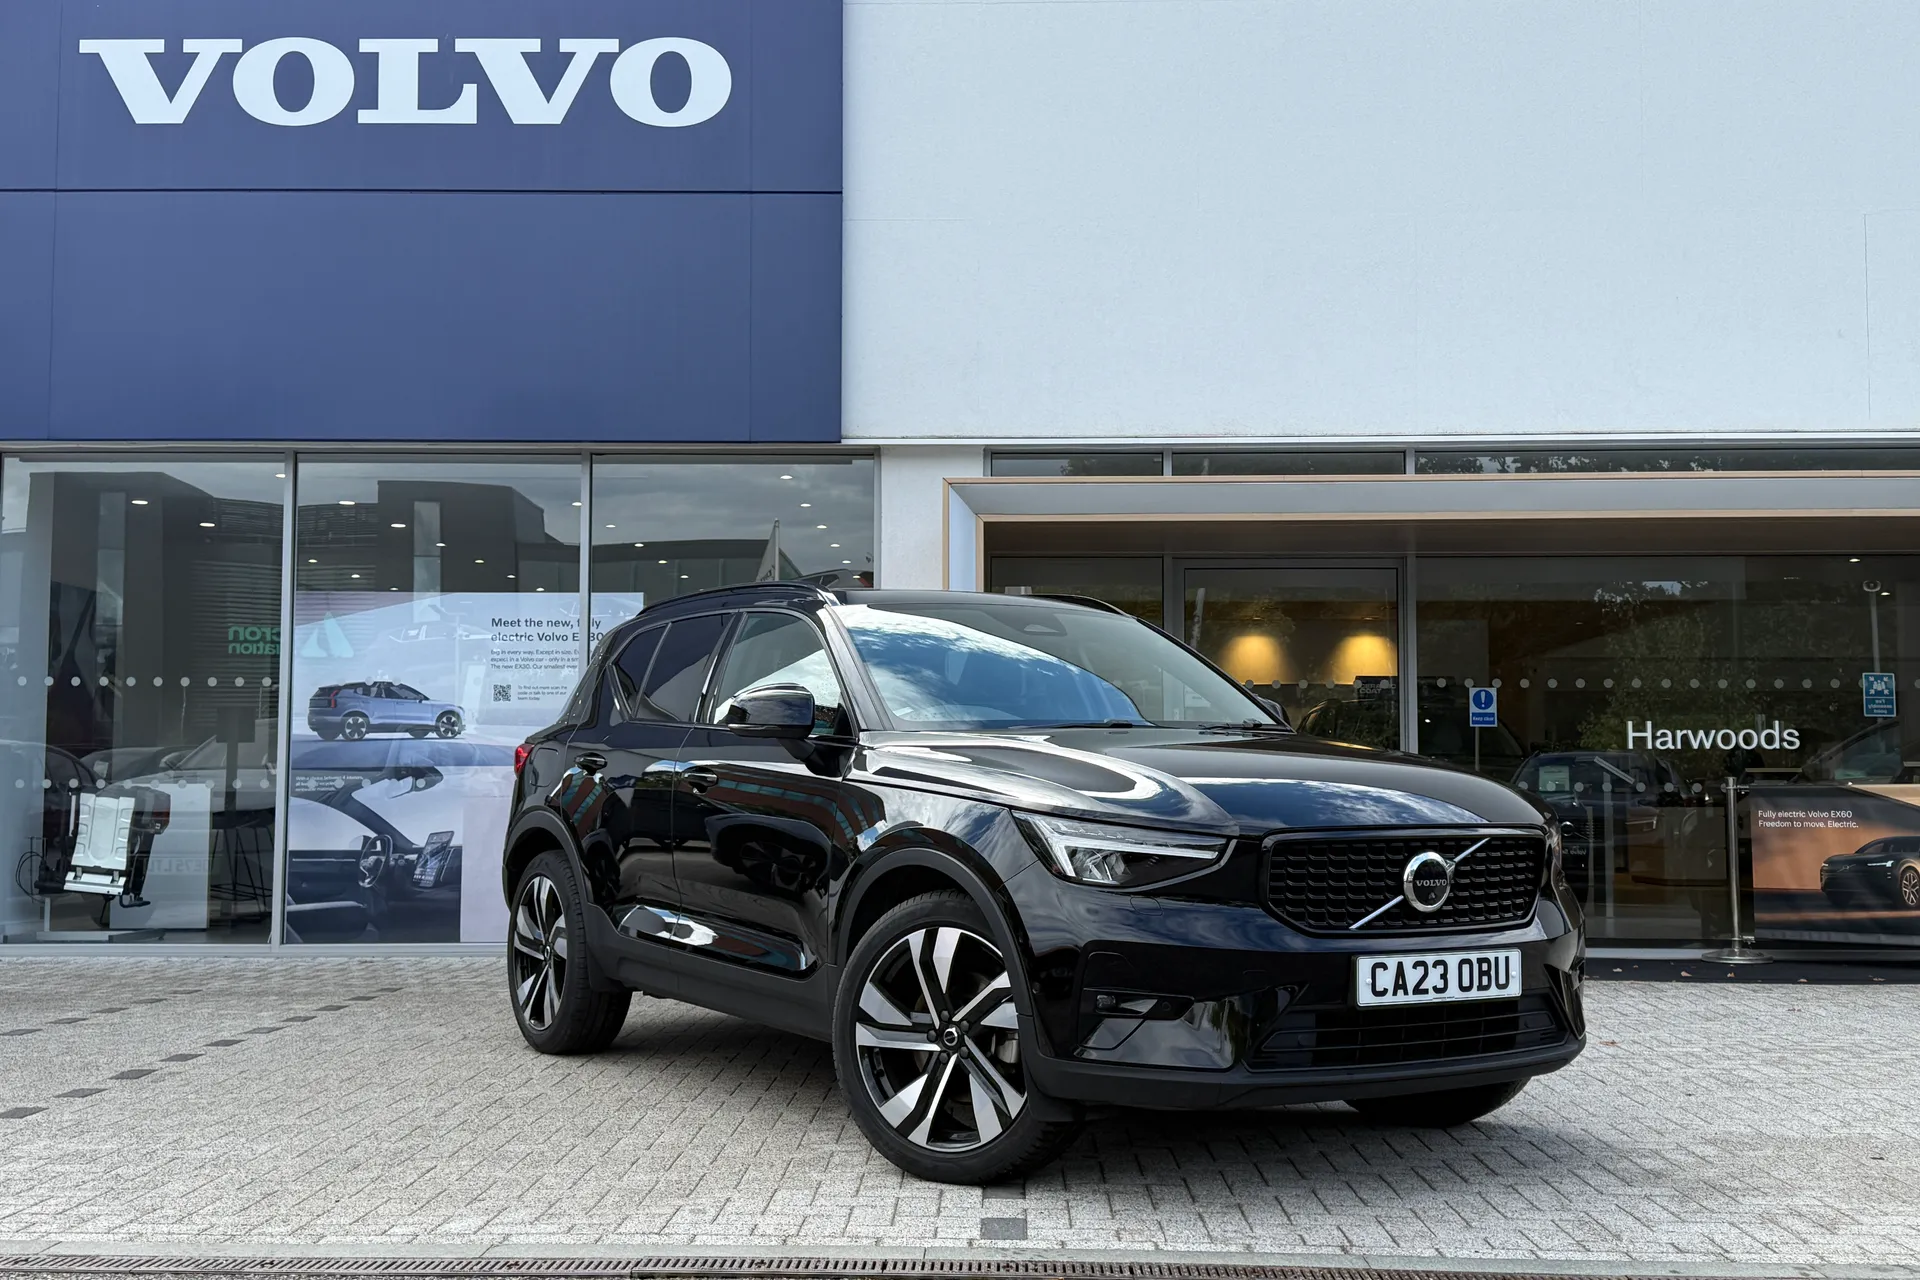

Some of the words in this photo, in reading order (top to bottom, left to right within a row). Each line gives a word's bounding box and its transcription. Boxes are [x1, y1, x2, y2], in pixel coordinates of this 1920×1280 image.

[79, 37, 732, 127] VOLVO
[491, 618, 521, 628] Meet
[525, 618, 543, 628] the
[547, 619, 574, 629] new,
[577, 618, 602, 629] fly
[491, 632, 534, 642] electric
[537, 632, 569, 642] Volvo
[572, 632, 604, 642] E30
[1626, 720, 1801, 750] Harwoods
[1758, 810, 1777, 819] Fully
[1777, 810, 1806, 818] electric
[1807, 810, 1830, 818] Volvo
[1830, 810, 1853, 819] EX60
[1758, 820, 1792, 828] Freedom
[1793, 820, 1802, 828] to
[1827, 820, 1859, 828] Electric.
[1416, 879, 1447, 887] VOLVO
[1371, 959, 1449, 998] CA23
[1457, 955, 1510, 993] OBU
